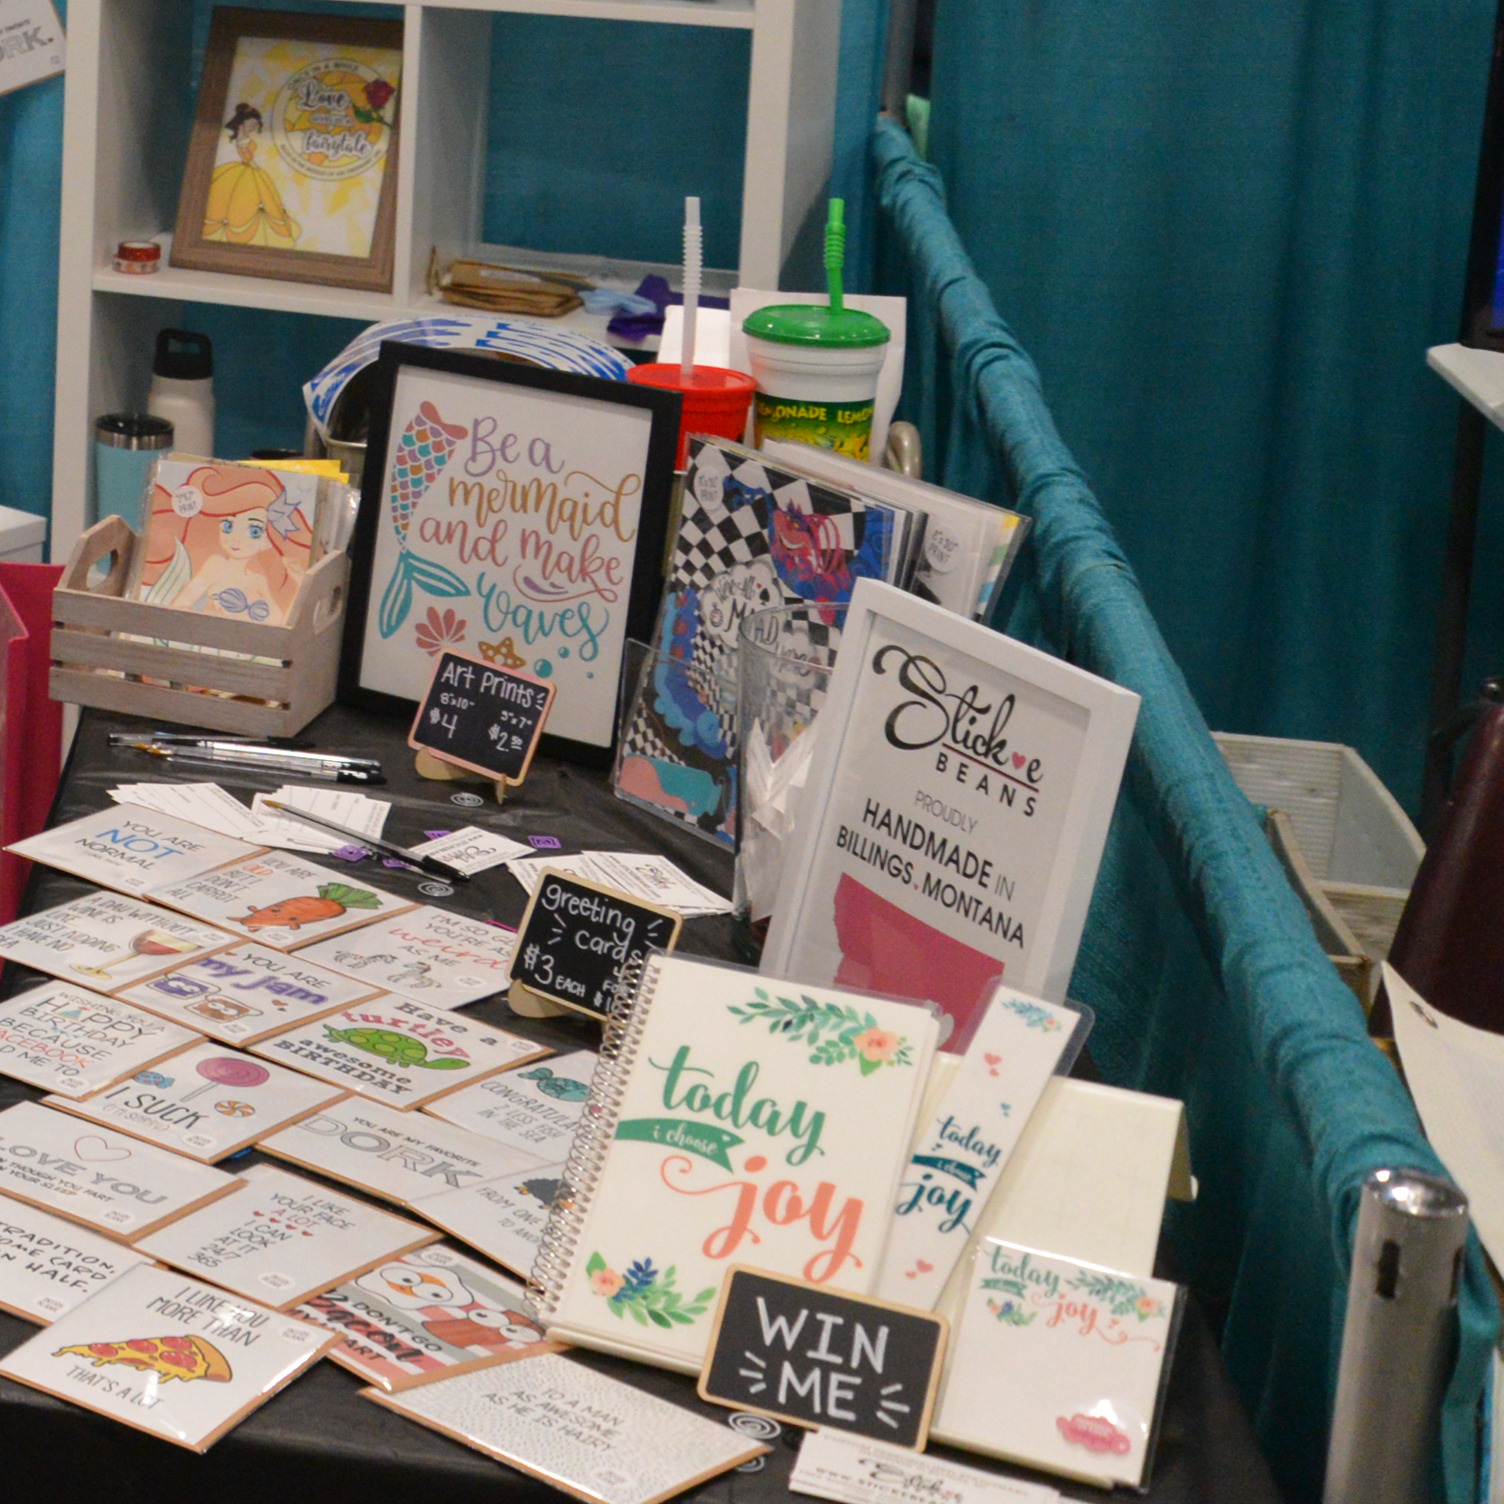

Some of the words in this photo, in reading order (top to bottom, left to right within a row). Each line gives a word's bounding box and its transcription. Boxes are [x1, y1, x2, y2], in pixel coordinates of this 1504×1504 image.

[301, 80, 348, 108] Love
[305, 129, 368, 158] fairytale
[464, 416, 520, 477] Be
[528, 438, 565, 474] a
[449, 469, 642, 542] mermaid
[418, 515, 509, 568] and
[518, 527, 624, 591] make
[440, 661, 475, 689] Art
[429, 707, 459, 739] $4
[935, 752, 1037, 819] BEANS
[914, 788, 979, 836] PROUDLY
[74, 837, 155, 871] NORMAL
[94, 828, 186, 860] NOT
[122, 820, 160, 841] YOU
[160, 831, 205, 854] ARE
[861, 797, 995, 890] HANDMADE
[994, 874, 1017, 901] IN
[127, 907, 197, 936] WITHOUT
[542, 883, 637, 944] greeting
[921, 874, 1027, 951] MONTANA
[388, 926, 506, 971] weird
[574, 930, 643, 967] cards
[242, 952, 287, 973] YOU
[282, 970, 332, 990] ARE
[554, 974, 587, 997] EACH
[19, 1006, 137, 1050] BIRTHDAY
[342, 1010, 471, 1059] turtley
[393, 1001, 469, 1035] Have
[17, 1050, 53, 1067] ME
[53, 1063, 81, 1077] TO
[272, 1038, 414, 1096] BIRTHDAY
[297, 1037, 413, 1088] awesome
[123, 1092, 214, 1132] SUCK
[649, 1045, 827, 1165] today
[295, 1112, 485, 1190] DORK
[424, 1141, 483, 1169] FAVORITE
[652, 1125, 661, 1140] i
[665, 1124, 720, 1158] choose
[936, 1115, 1002, 1168] today
[5, 1159, 55, 1184] THOUGH
[90, 1171, 172, 1208] YOU
[270, 1193, 315, 1215] YOUR
[312, 1210, 356, 1231] FACE
[682, 1155, 867, 1284] joy
[895, 1170, 974, 1237] joy
[253, 1223, 294, 1244] CAN
[25, 1262, 91, 1295] HALF.
[47, 1253, 109, 1283] CARD
[186, 1252, 224, 1270] 365
[983, 1244, 1063, 1296] today
[146, 1295, 206, 1327] MORE
[205, 1316, 262, 1349] THAN
[352, 1300, 415, 1336] DON'T
[1038, 1293, 1104, 1337] joy
[756, 1296, 890, 1374] WIN
[65, 1363, 118, 1395] THAT'S
[777, 1368, 861, 1422] ME
[533, 1398, 621, 1442] AWESOME
[579, 1407, 625, 1427] MAN
[555, 1421, 615, 1453] HAIRY
